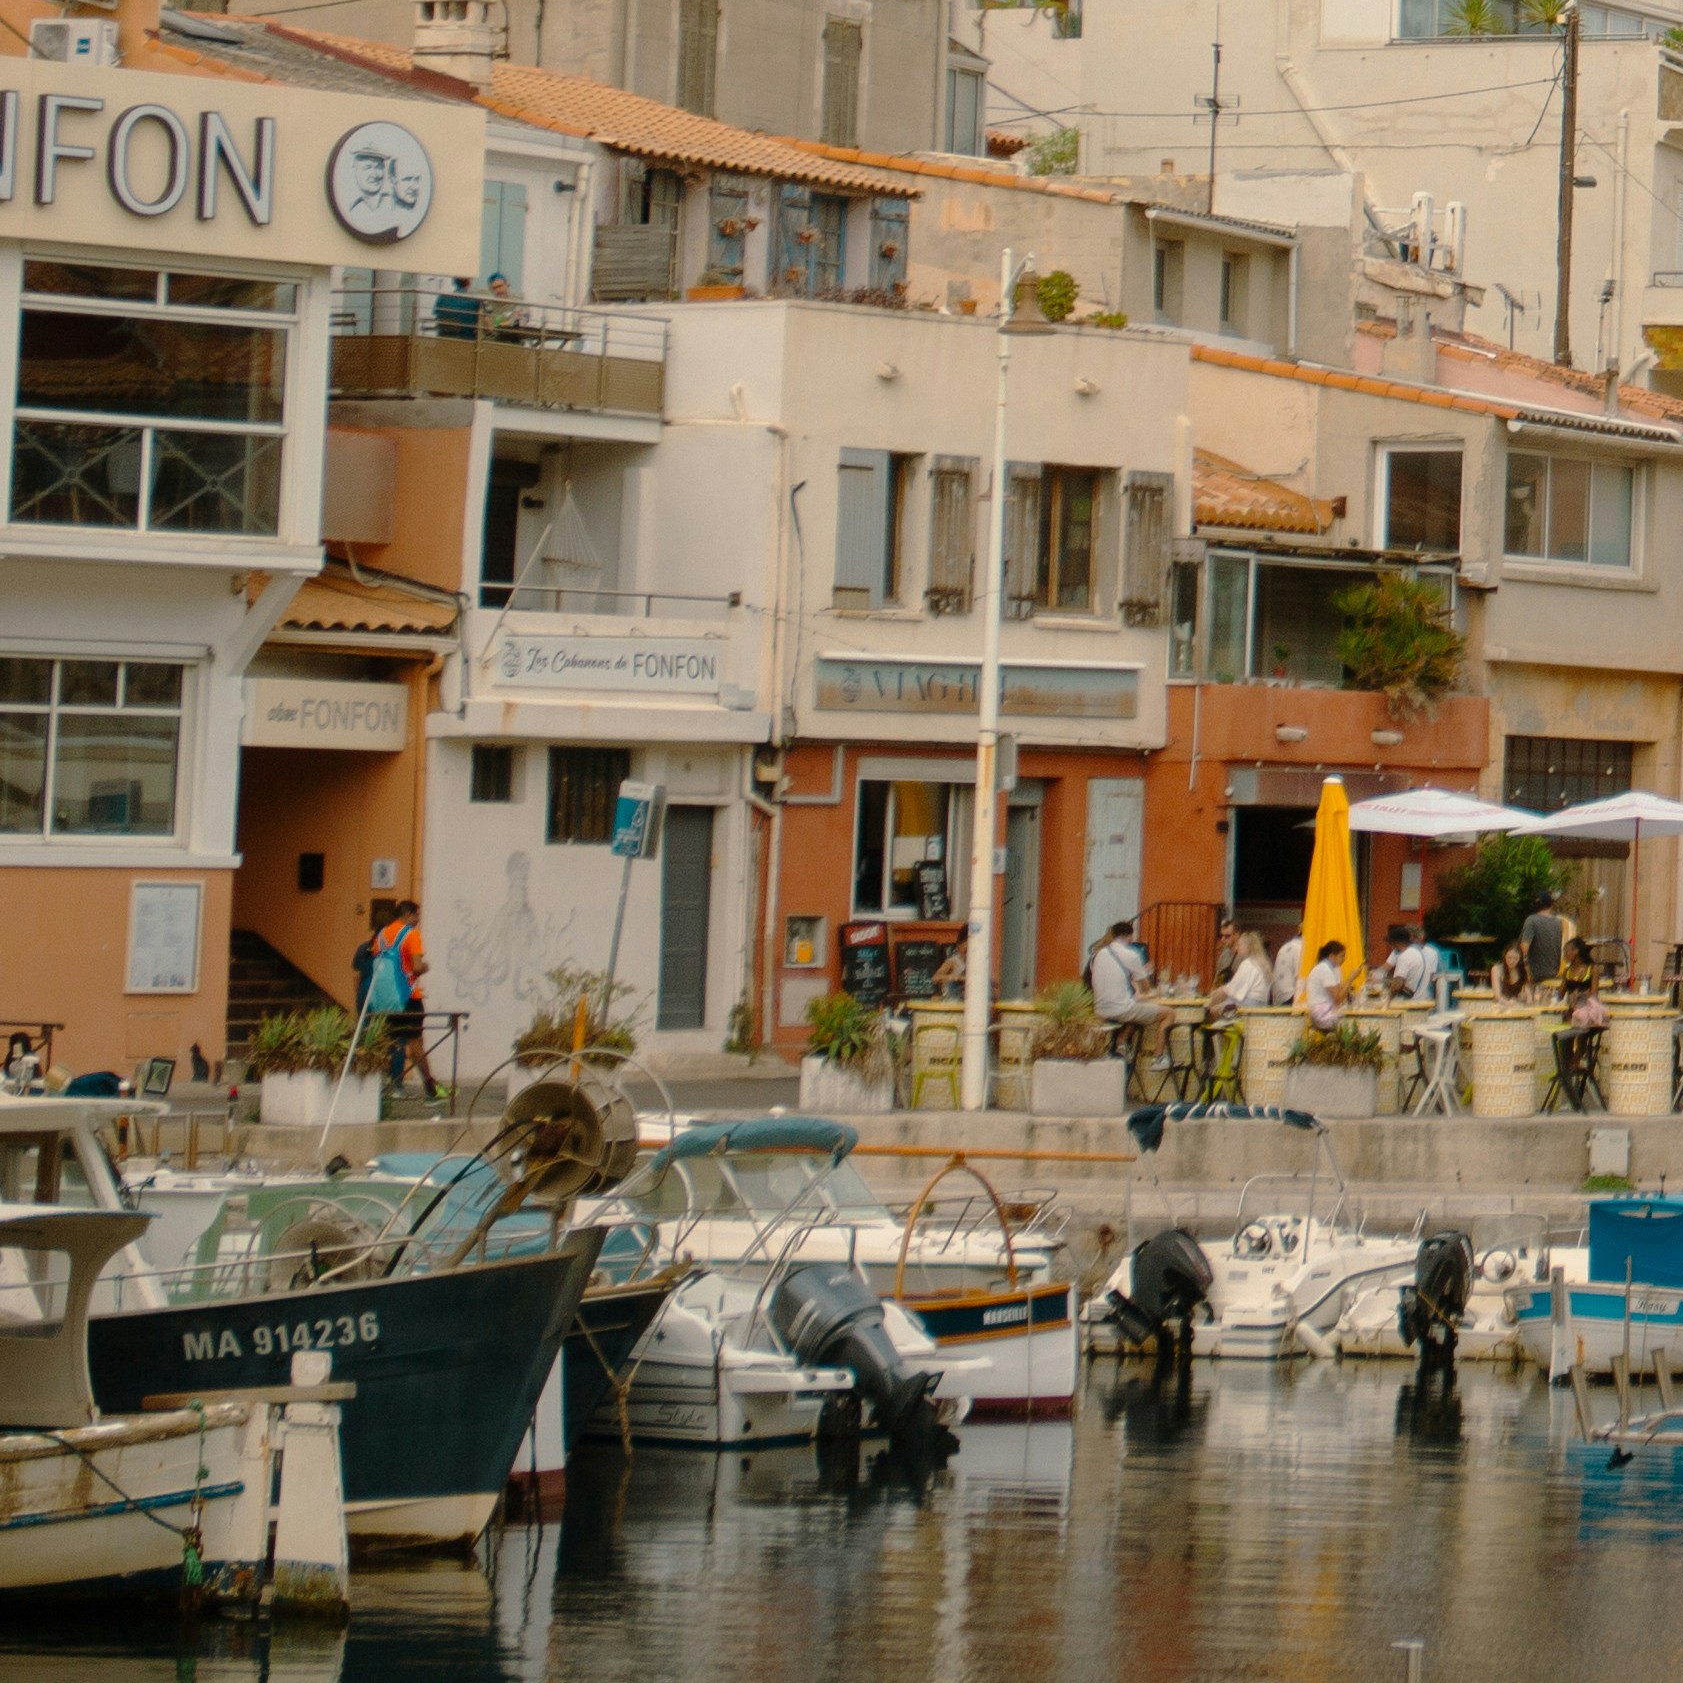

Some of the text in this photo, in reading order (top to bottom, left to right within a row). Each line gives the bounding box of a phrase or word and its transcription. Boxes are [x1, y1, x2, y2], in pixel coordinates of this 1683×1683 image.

[0, 89, 275, 226] FON
[632, 652, 716, 680] FONFON
[300, 698, 401, 733] FONFON
[182, 1311, 381, 1362] MA 914236
